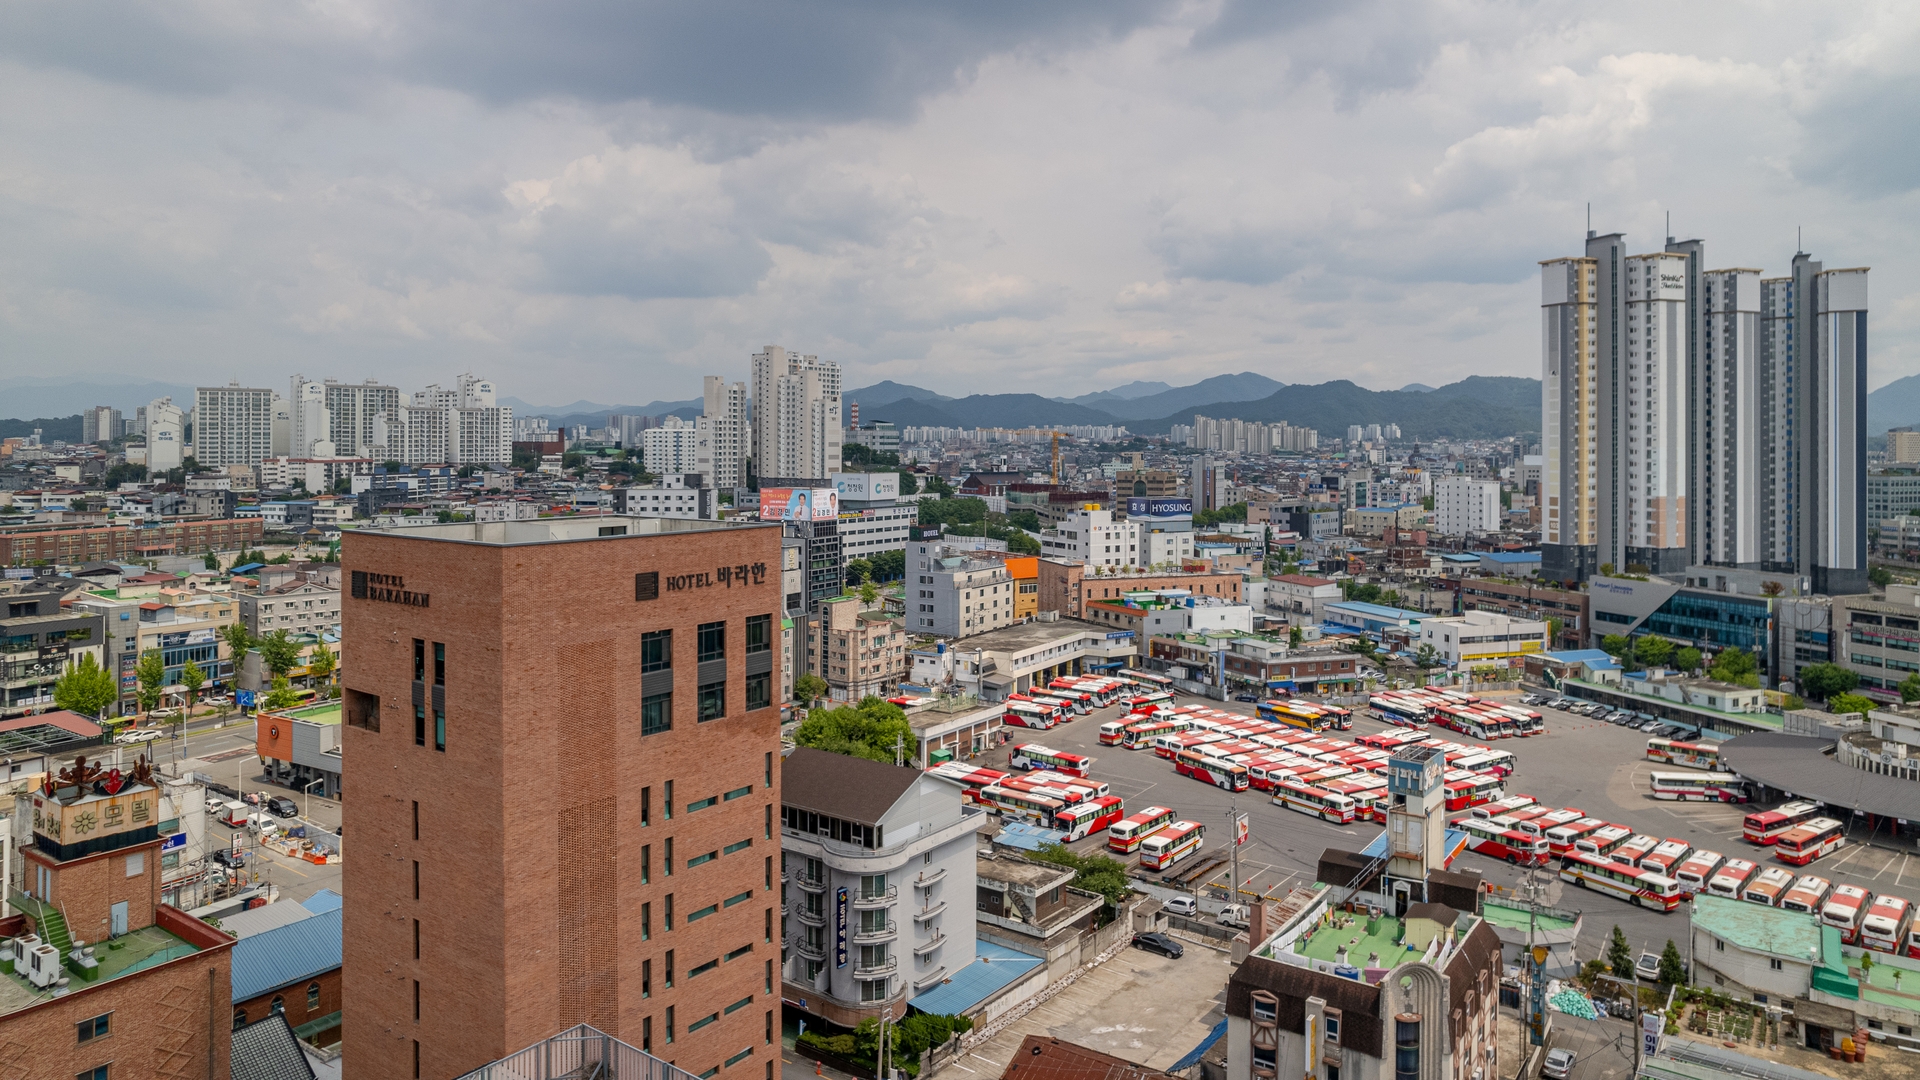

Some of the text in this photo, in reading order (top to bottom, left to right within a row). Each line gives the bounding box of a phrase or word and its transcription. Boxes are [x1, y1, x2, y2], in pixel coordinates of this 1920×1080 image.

[847, 483, 863, 493] 청정원
[882, 484, 894, 493] 청정원
[762, 505, 769, 516] 2
[1131, 502, 1146, 512] 효성
[1152, 503, 1192, 513] HYOSUNG
[923, 530, 939, 538] HOTEL
[369, 572, 405, 587] HOTEL
[666, 562, 767, 592] HOTEL 바라한
[369, 586, 430, 608] BARAHAN
[103, 799, 150, 829] 모텔
